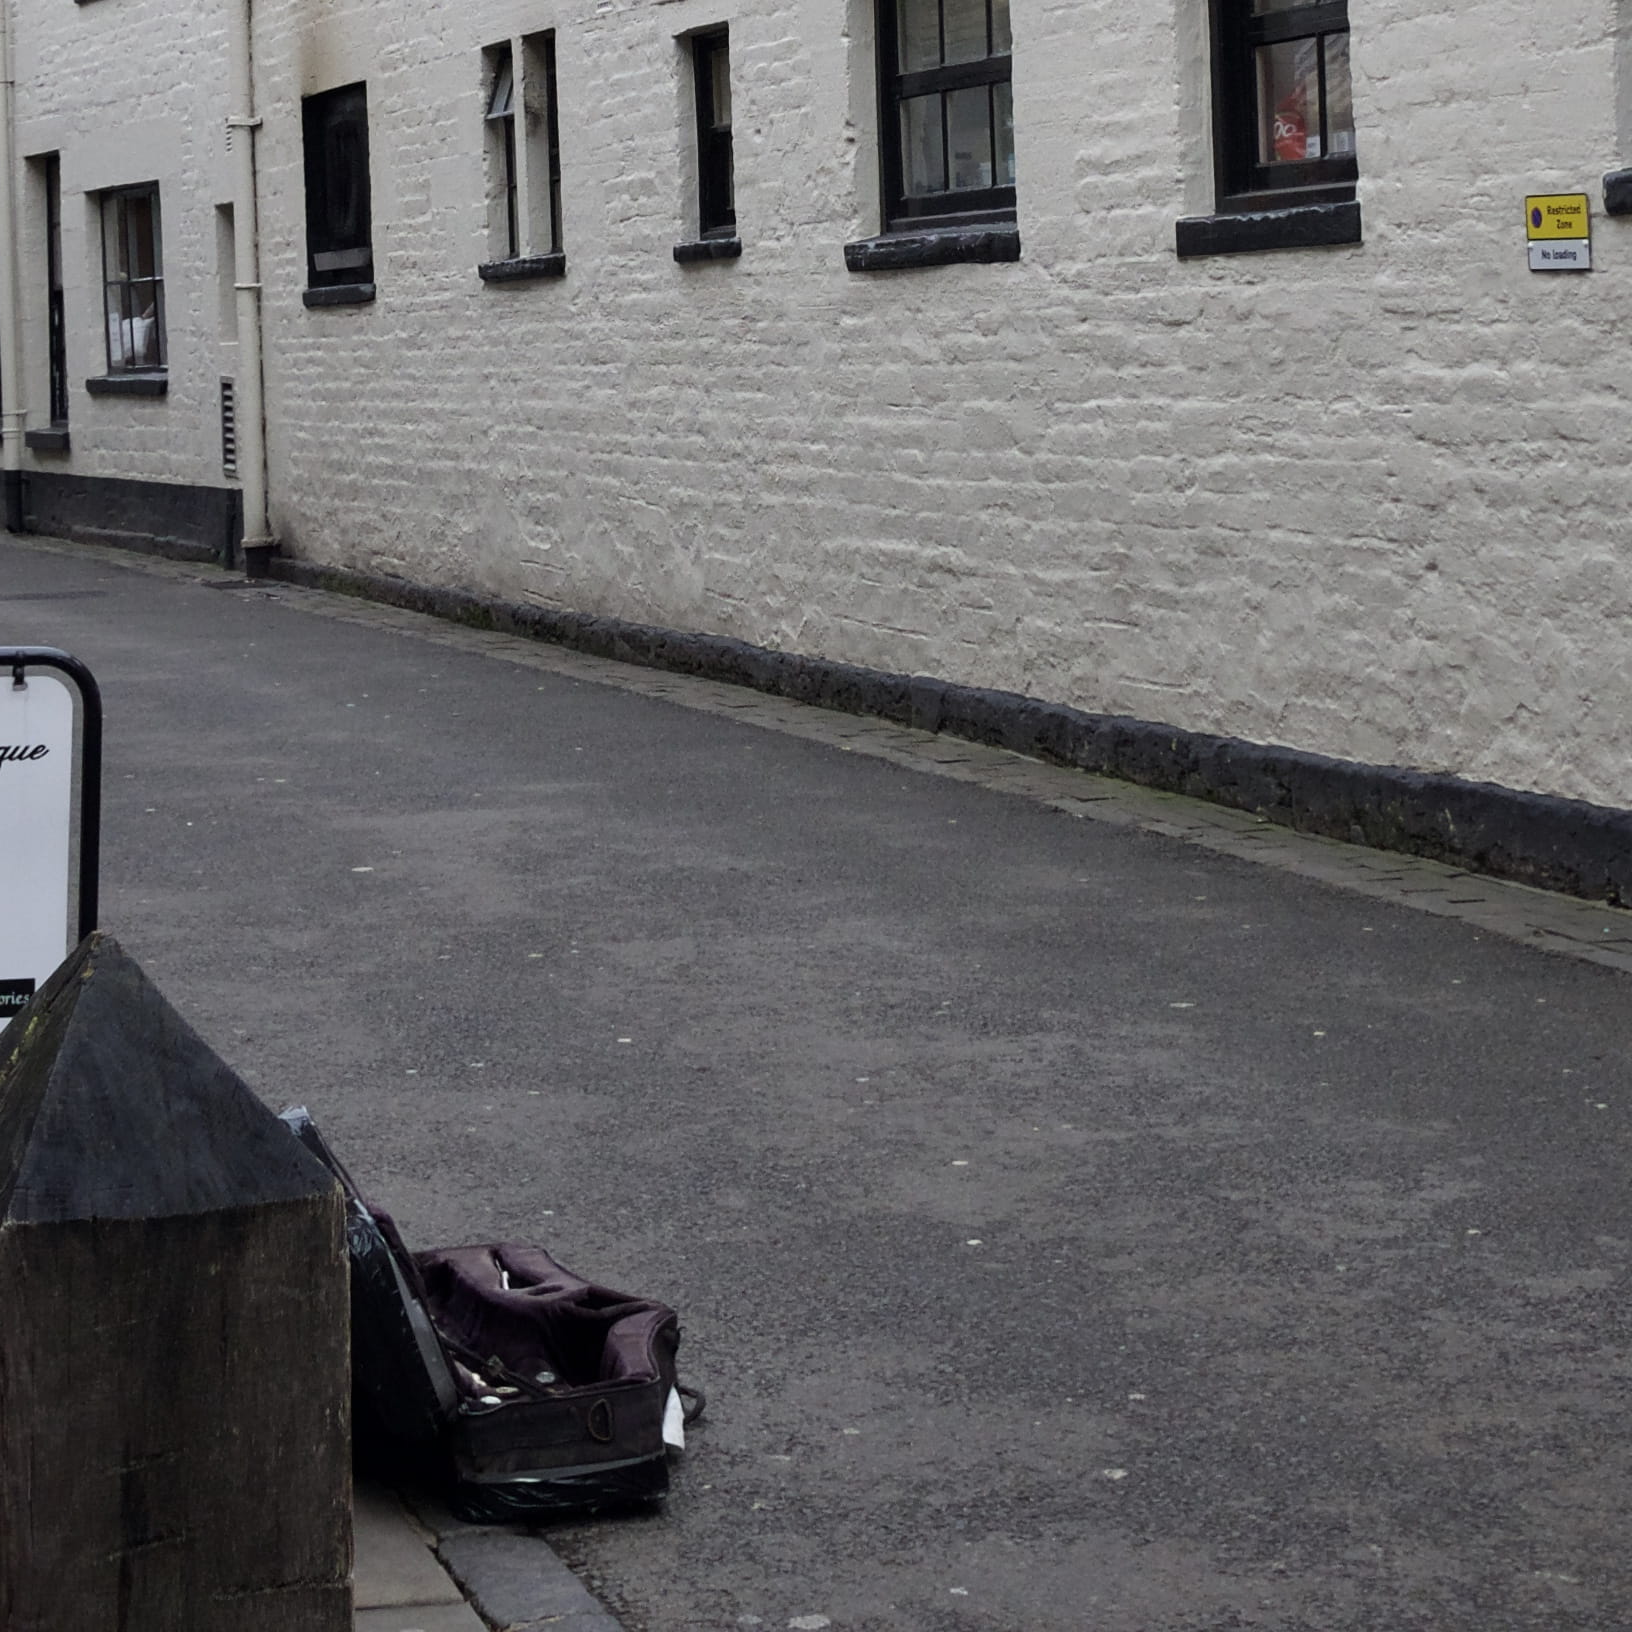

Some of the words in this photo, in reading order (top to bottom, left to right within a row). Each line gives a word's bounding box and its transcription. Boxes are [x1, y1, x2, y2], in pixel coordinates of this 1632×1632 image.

[1546, 204, 1581, 215] Restricted
[1556, 219, 1573, 230] Zone
[1541, 249, 1551, 260] No
